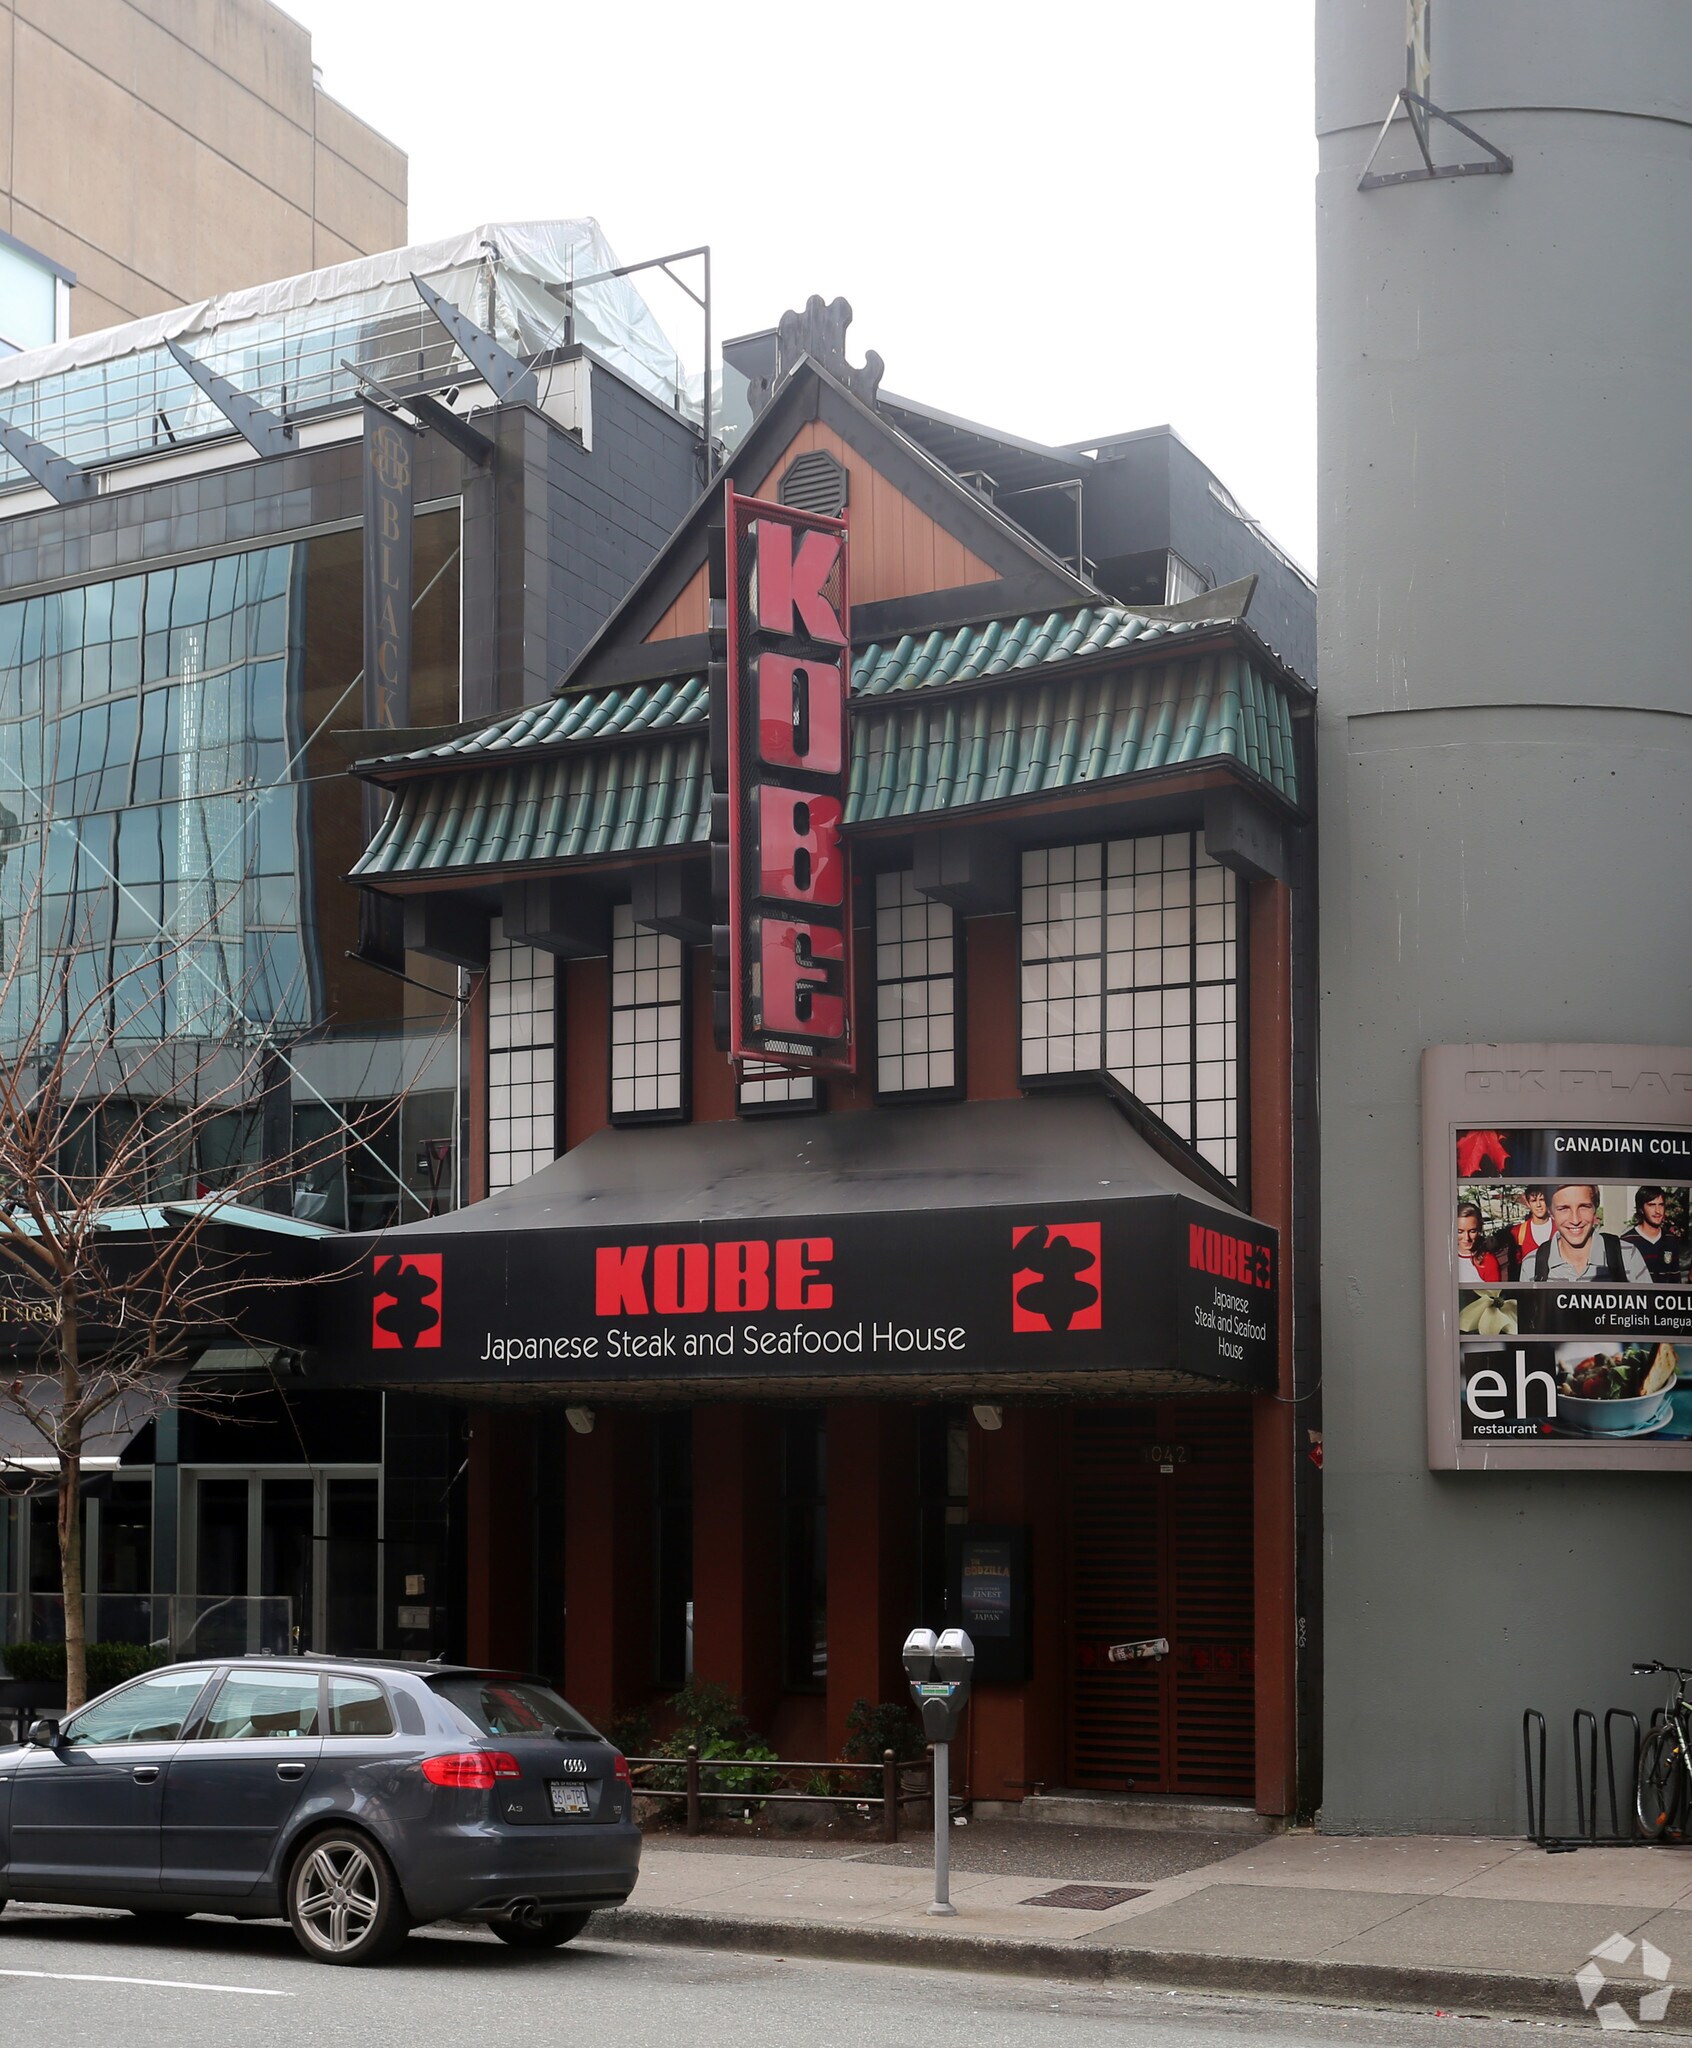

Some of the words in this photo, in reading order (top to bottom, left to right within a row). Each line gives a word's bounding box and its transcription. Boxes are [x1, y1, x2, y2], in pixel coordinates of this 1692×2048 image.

[377, 495, 401, 729] BLACK
[754, 517, 849, 1040] KOBE
[1553, 1136, 1643, 1153] CANADIAN
[1189, 1223, 1253, 1285] KOBE
[596, 1237, 834, 1315] KOBE
[1213, 1286, 1249, 1314] Japanese
[1556, 1294, 1647, 1310] CANADIAN
[1194, 1306, 1216, 1330] Steak
[1217, 1314, 1233, 1334] and
[1233, 1316, 1266, 1341] Seafood
[1595, 1314, 1606, 1325] of
[1610, 1314, 1650, 1328] English
[480, 1331, 599, 1366] Japanese
[606, 1329, 675, 1359] Steak
[684, 1321, 734, 1356] and
[743, 1321, 864, 1355] Seafood
[872, 1322, 966, 1352] House
[1218, 1336, 1244, 1360] House
[1466, 1350, 1557, 1420] eh
[1473, 1424, 1538, 1434] restaurant
[964, 1566, 1010, 1577] GODZILLA
[974, 1613, 1000, 1621] JAPAN
[507, 1803, 523, 1812] A3
